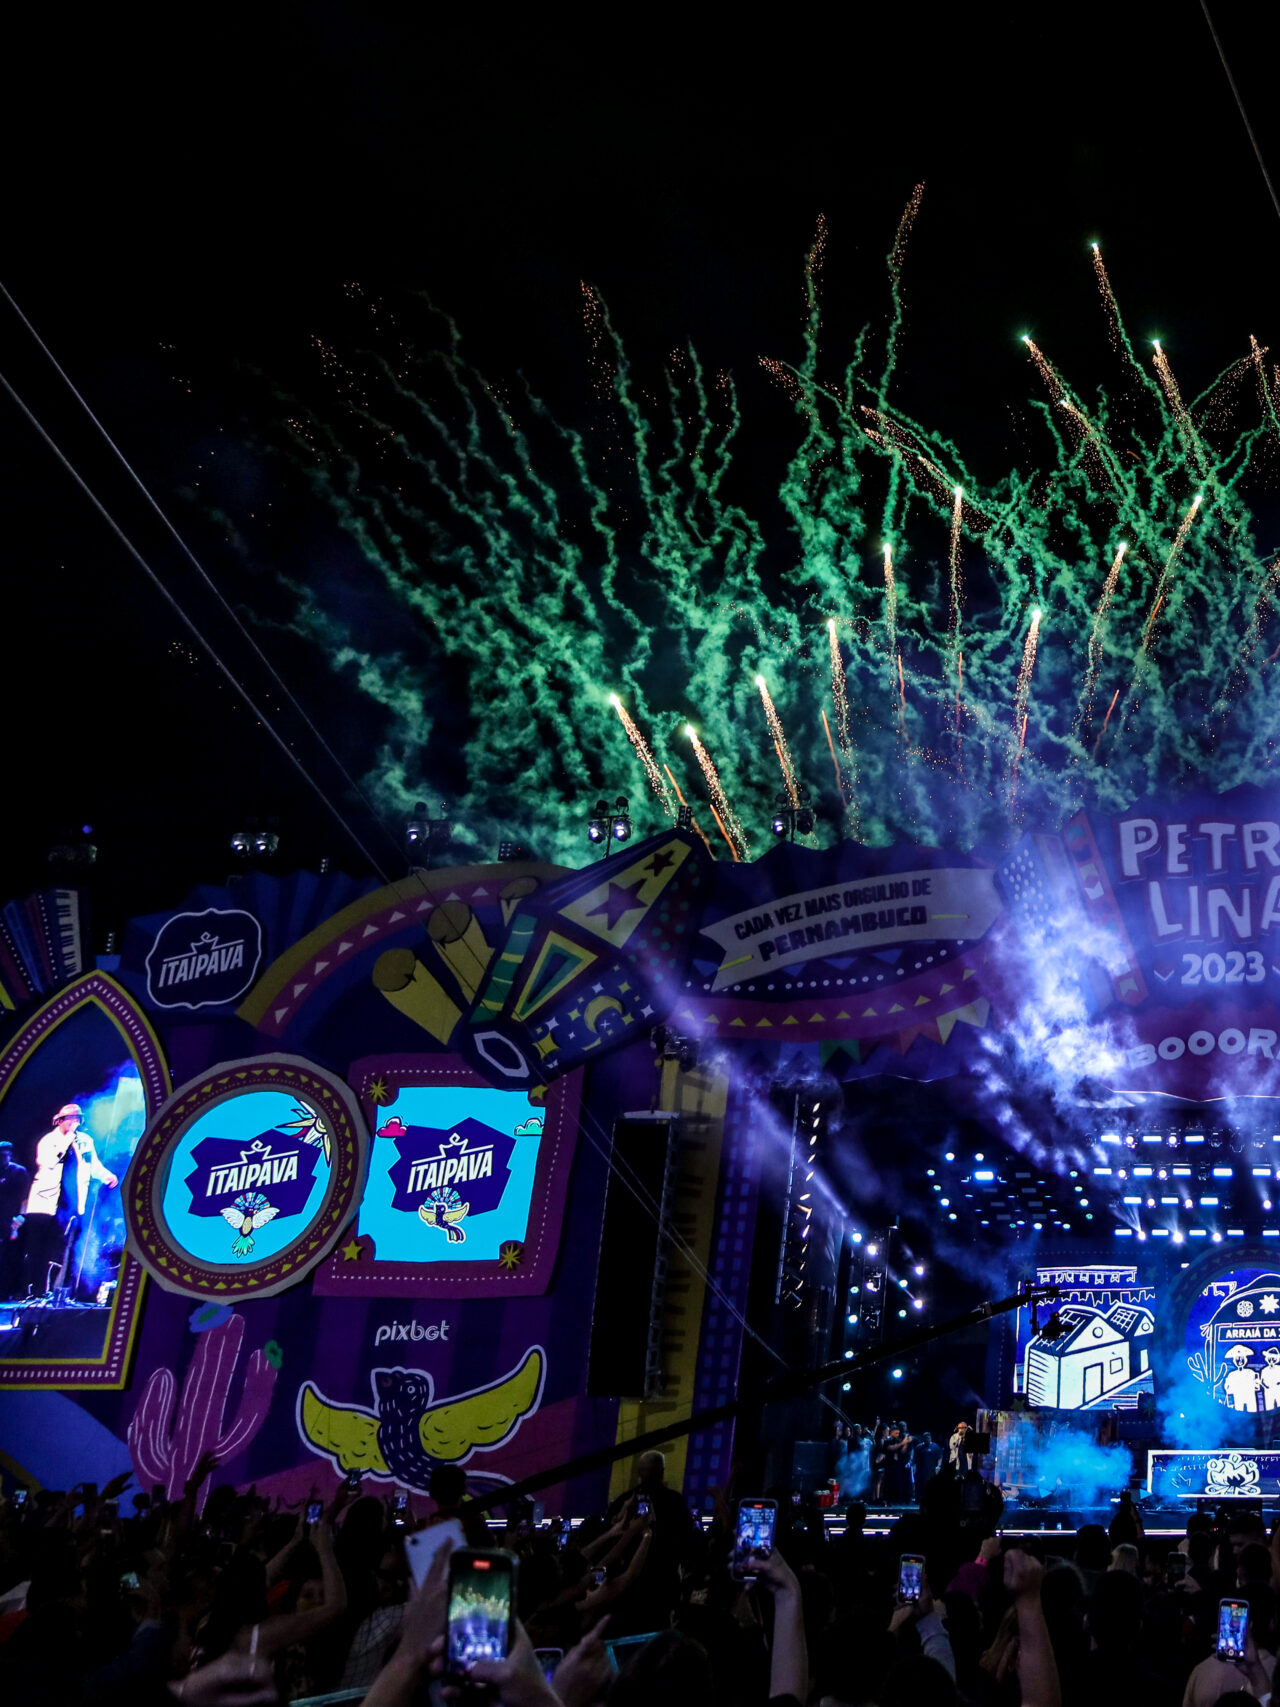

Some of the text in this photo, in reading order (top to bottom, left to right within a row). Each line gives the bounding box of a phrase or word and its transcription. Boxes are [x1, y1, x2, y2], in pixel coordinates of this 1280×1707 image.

[734, 878, 932, 940] CADA VEZ MAIS ORGULHO DE
[758, 905, 928, 962] PERNAMBUCO
[158, 944, 244, 988] ITAIPAVA
[1180, 950, 1266, 985] 2023
[205, 1155, 299, 1197] ITAIPAVA
[406, 1150, 493, 1194] ITAIPAVA
[1225, 1326, 1261, 1339] ARRAIÁ
[1263, 1327, 1277, 1338] DA
